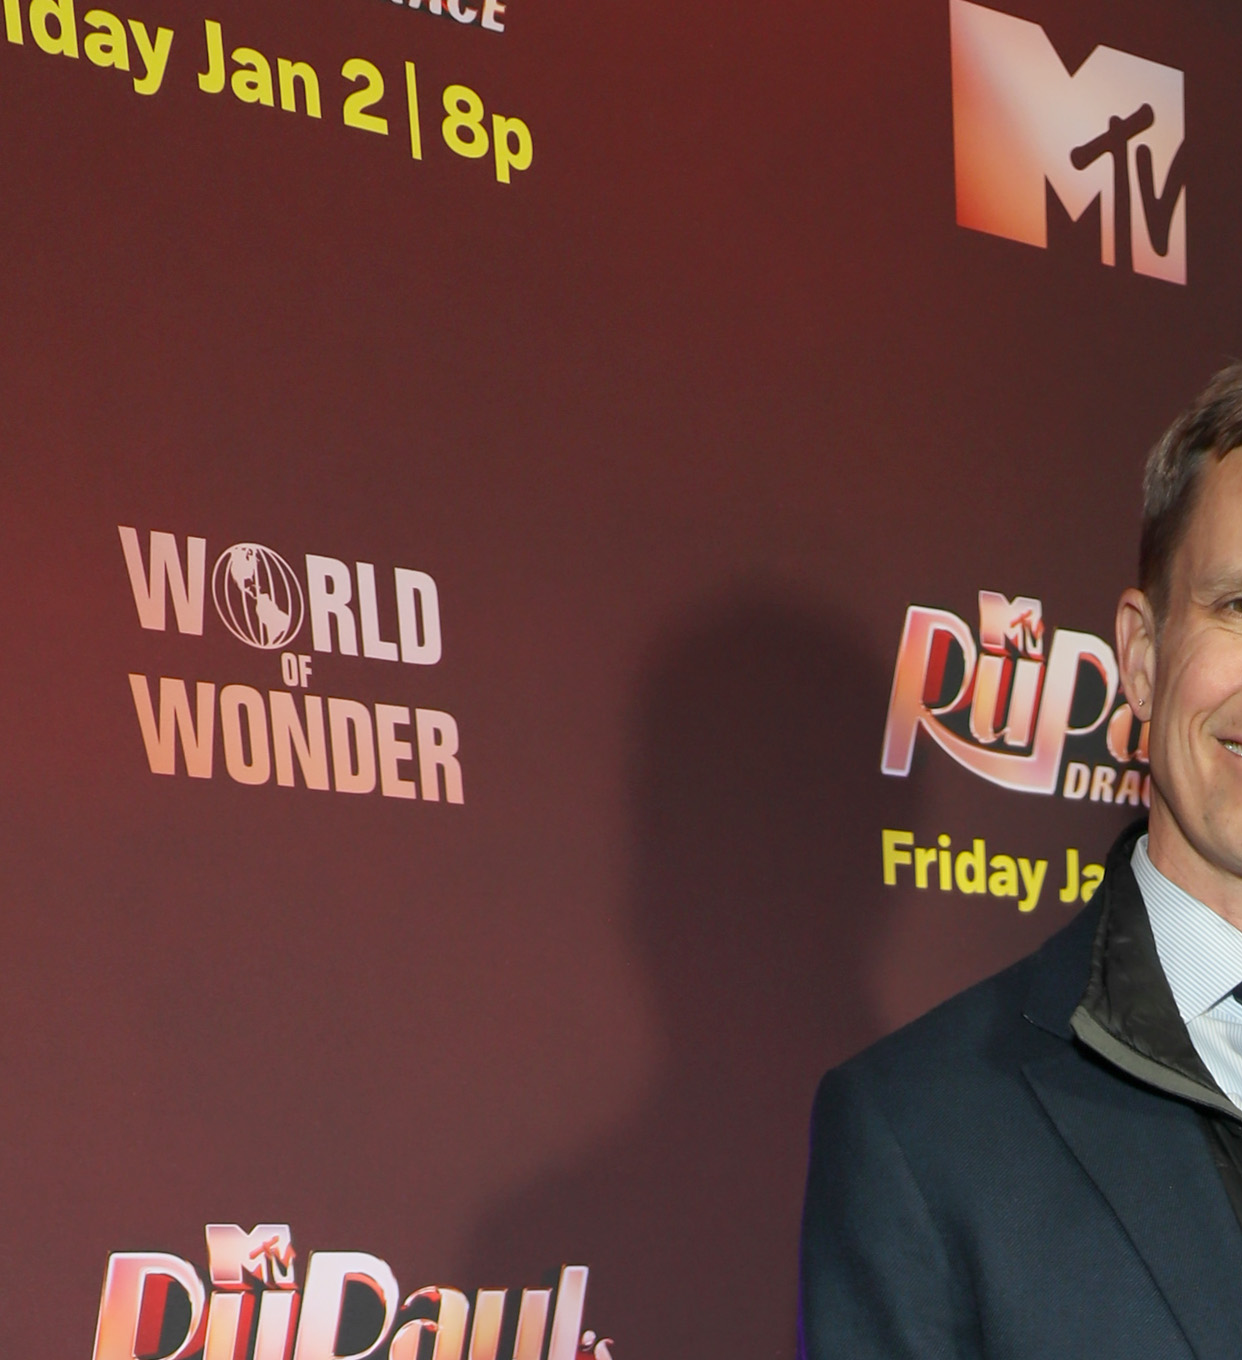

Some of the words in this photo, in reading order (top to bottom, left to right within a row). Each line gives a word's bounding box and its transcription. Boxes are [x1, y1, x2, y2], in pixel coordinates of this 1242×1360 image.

[0, 0, 174, 96] iday
[197, 19, 322, 119] Jan
[341, 57, 389, 136] 2
[441, 84, 534, 184] 8p
[949, 0, 1189, 286] MTV
[118, 525, 443, 666] WORLD
[979, 589, 1044, 657] MTV
[281, 652, 313, 688] OF
[128, 673, 465, 805] WONDER
[881, 828, 1048, 913] Friday
[1059, 848, 1105, 904] Ja
[205, 1223, 297, 1286] MTV
